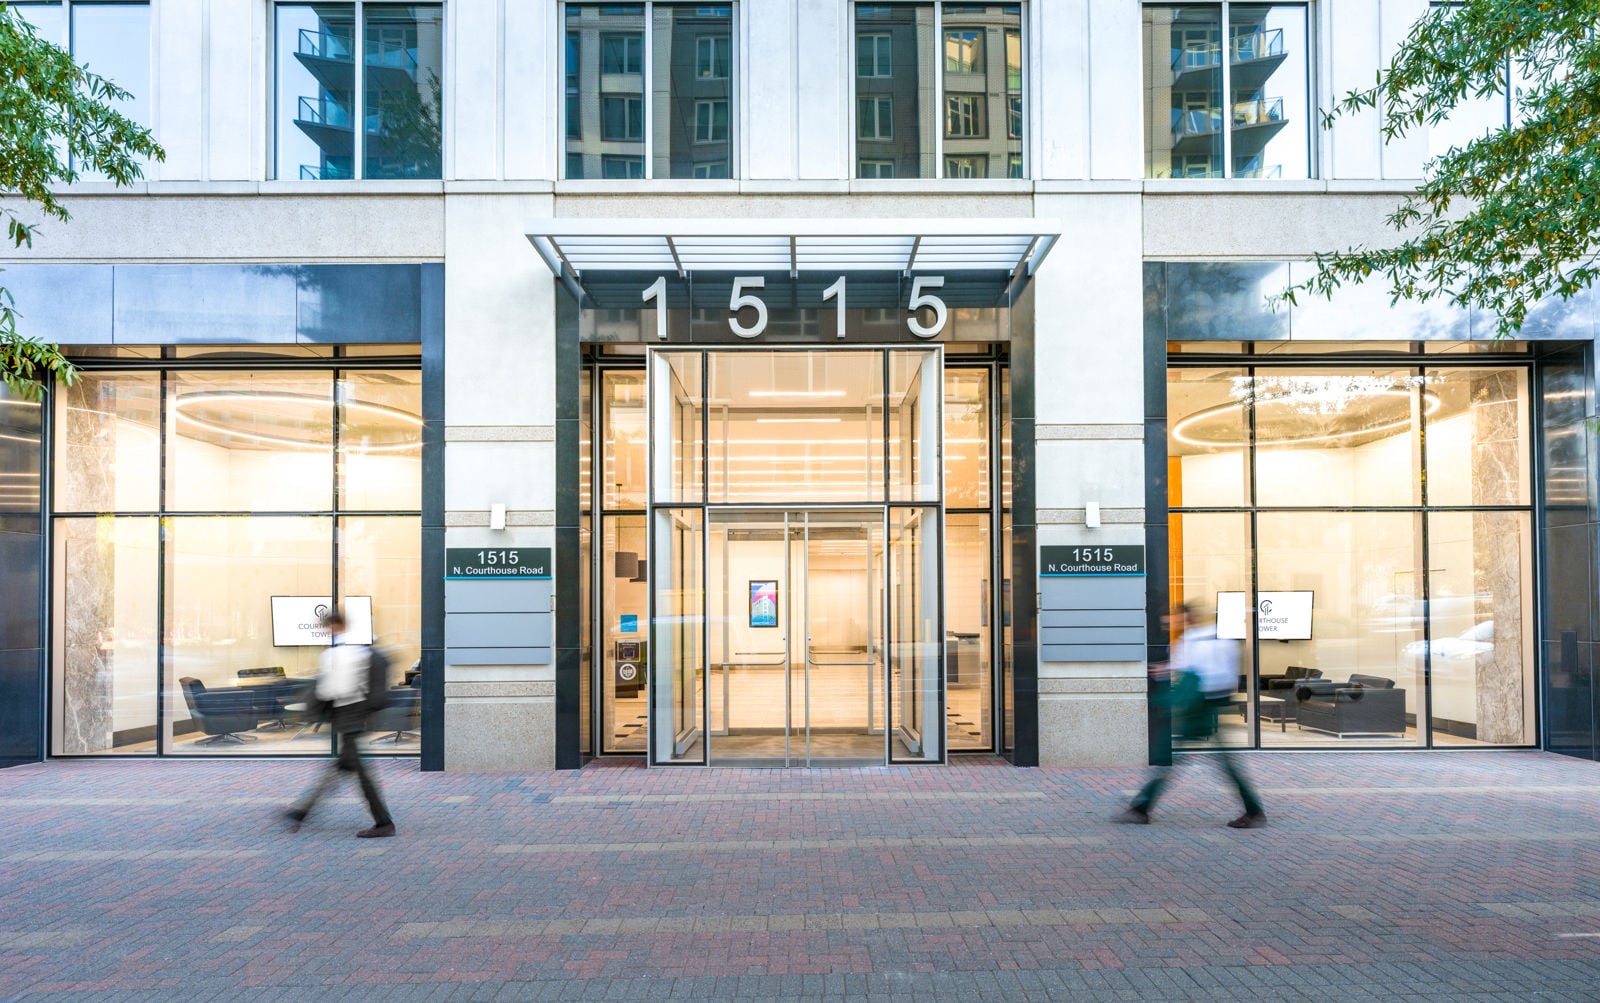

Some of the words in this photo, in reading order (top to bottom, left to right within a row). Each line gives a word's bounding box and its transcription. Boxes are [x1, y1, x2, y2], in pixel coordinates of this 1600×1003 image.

[642, 276, 947, 339] 1515
[477, 550, 519, 565] 1515
[1072, 548, 1114, 562] 1515
[453, 566, 464, 575] N.
[465, 566, 518, 575] Courthouse
[519, 566, 544, 575] Road
[1048, 563, 1059, 572] N.
[1060, 563, 1112, 572] Courthouse
[1113, 563, 1138, 572] Road
